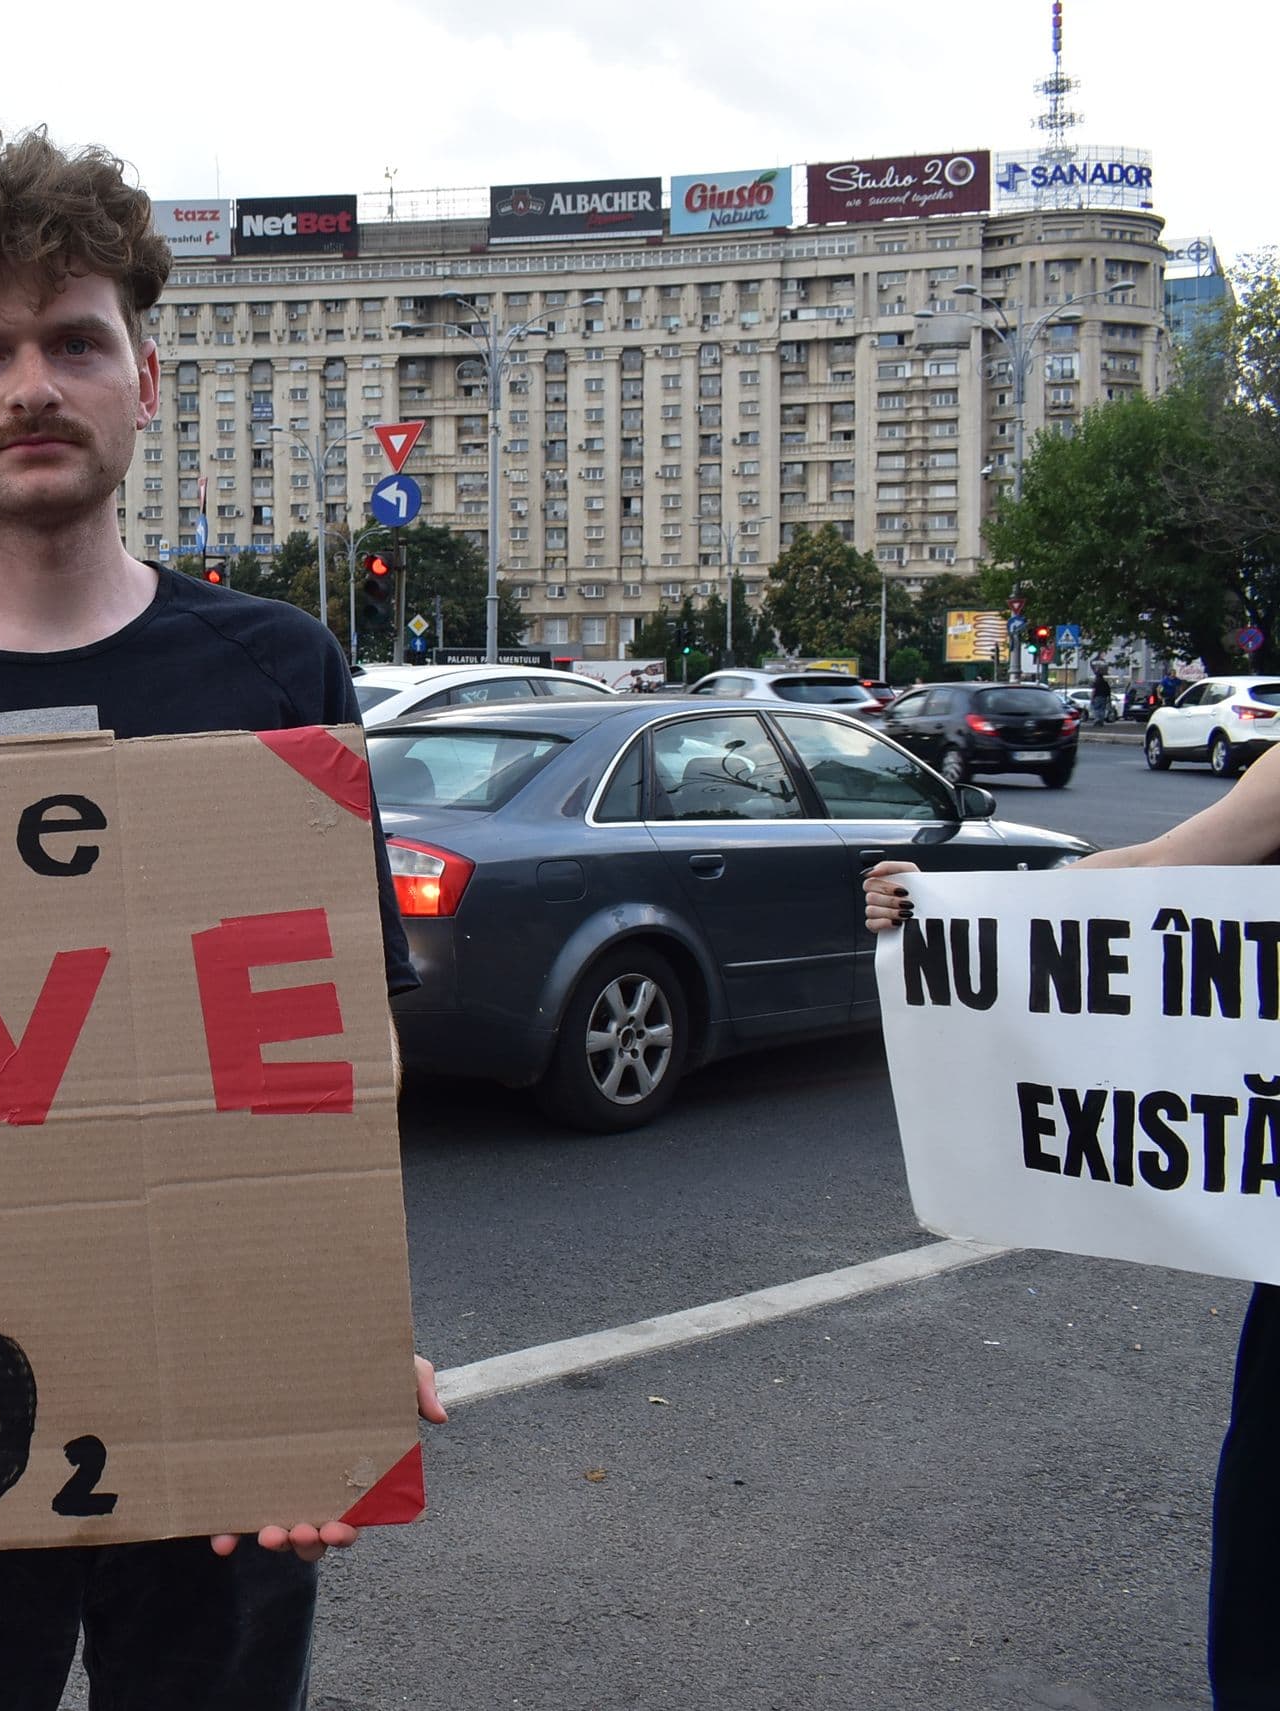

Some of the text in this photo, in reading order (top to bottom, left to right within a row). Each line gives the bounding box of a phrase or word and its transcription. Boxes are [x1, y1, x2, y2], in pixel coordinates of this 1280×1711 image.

[825, 164, 918, 192] Studio
[1030, 162, 1153, 189] SANADOR
[548, 190, 656, 216] ALBACHER
[684, 180, 775, 213] Giusto
[172, 207, 220, 222] tazz
[241, 209, 353, 238] NetBet
[707, 208, 769, 229] Natura
[447, 655, 540, 665] PALATUL PAAMENTULUI
[901, 917, 999, 1011] NU
[1028, 918, 1132, 1016] NE
